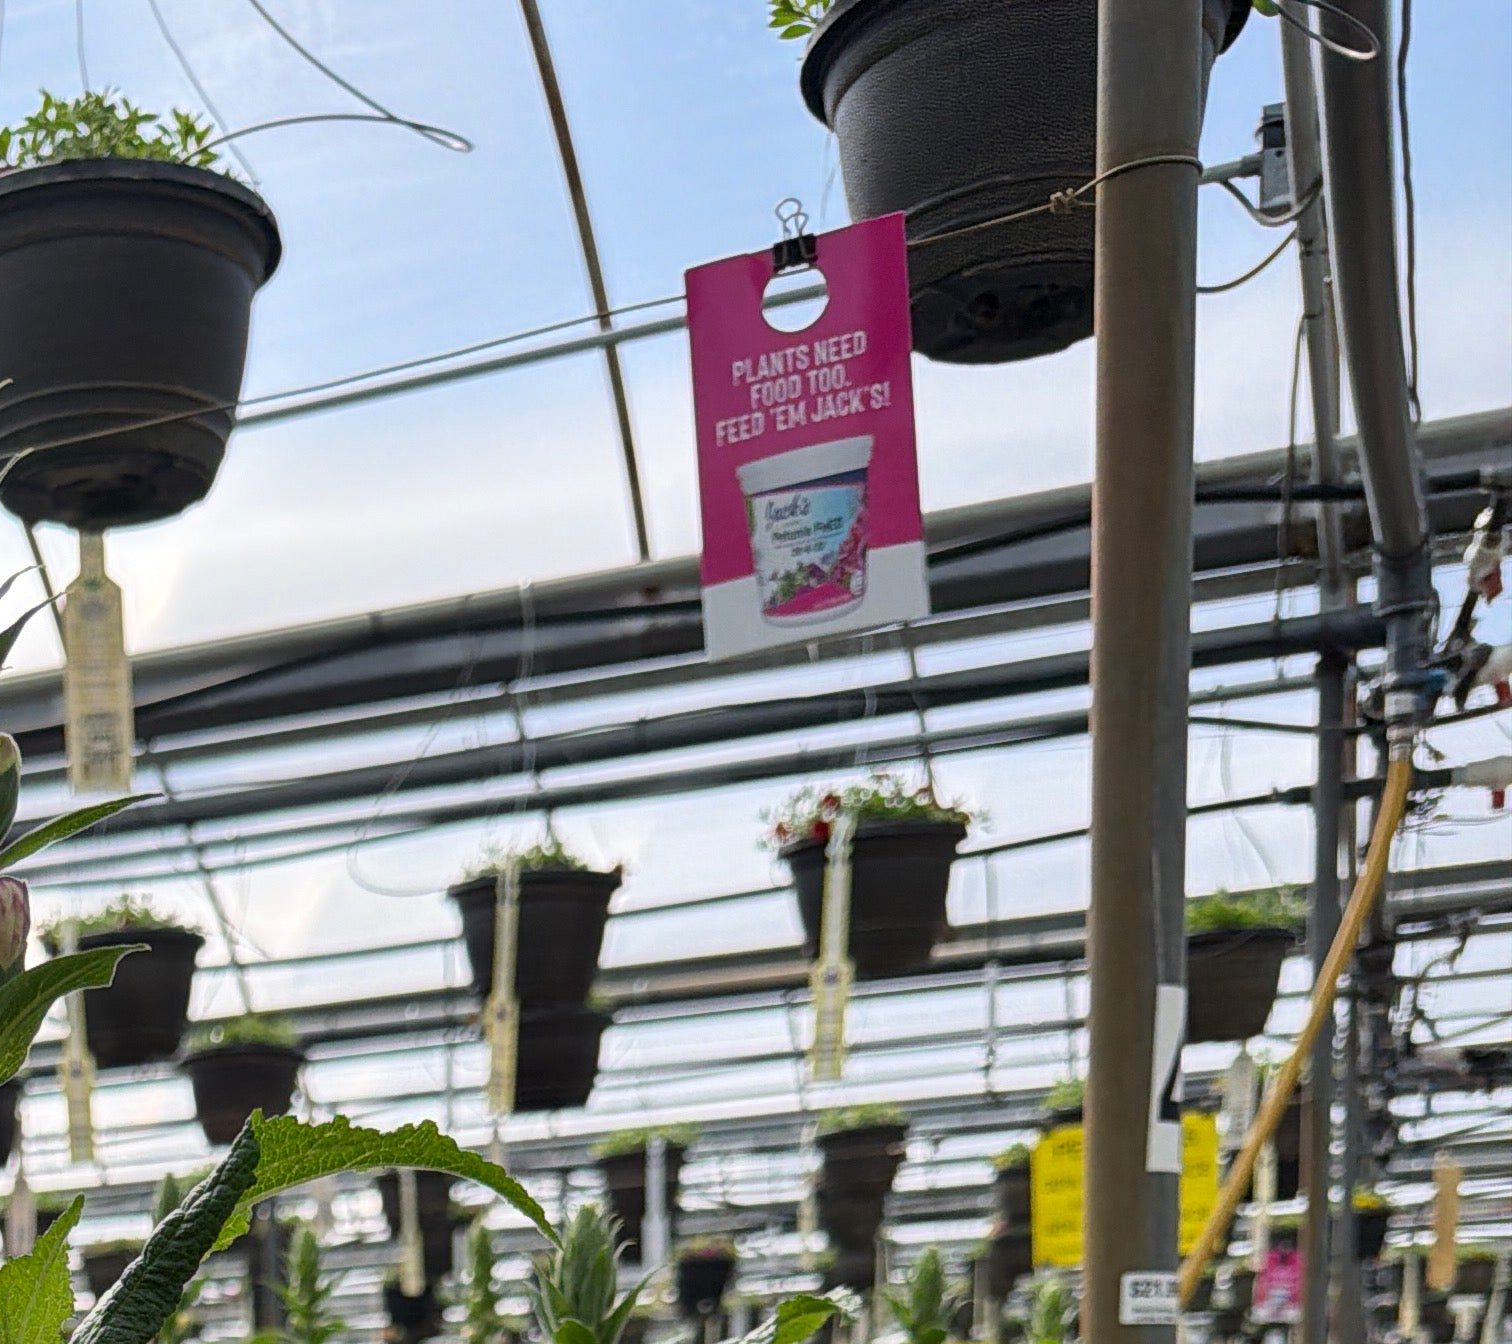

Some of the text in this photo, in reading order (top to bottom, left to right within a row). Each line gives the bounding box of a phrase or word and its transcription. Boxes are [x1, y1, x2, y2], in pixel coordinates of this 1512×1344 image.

[731, 330, 867, 387] PLANTS NEED
[750, 363, 852, 410] FOOD TOO.
[715, 380, 892, 447] FEED 'EM JACK'S!
